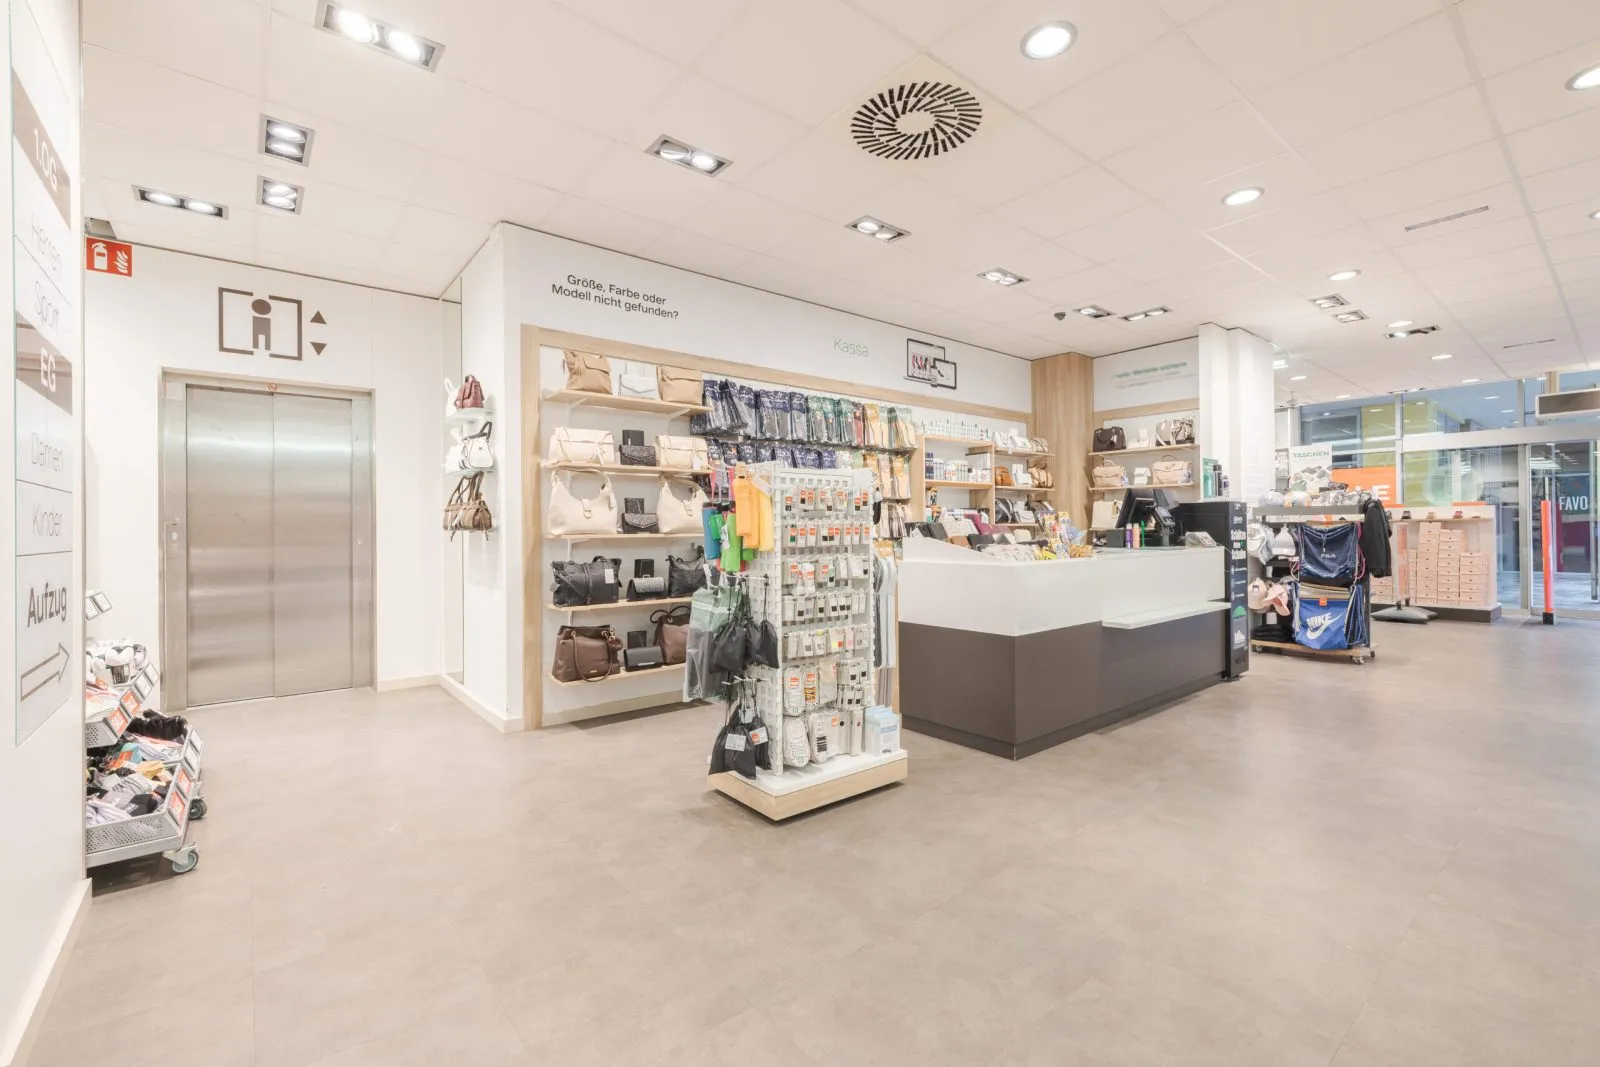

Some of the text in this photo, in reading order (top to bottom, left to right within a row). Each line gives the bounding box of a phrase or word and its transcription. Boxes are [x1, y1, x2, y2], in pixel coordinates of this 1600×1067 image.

[33, 129, 58, 192] 1.OG
[31, 211, 62, 280] Herren
[552, 284, 679, 320] Modell nicht gefunden?
[567, 274, 667, 305] Größe, Farbe oder
[833, 336, 869, 357] Kassa
[40, 347, 57, 393] EG
[31, 431, 64, 473] Damen
[1292, 450, 1330, 459] TASCHEN
[32, 503, 64, 537] Kinder
[1559, 495, 1588, 511] FAVO
[26, 581, 67, 628] Aufzug
[1306, 612, 1333, 631] NIKE
